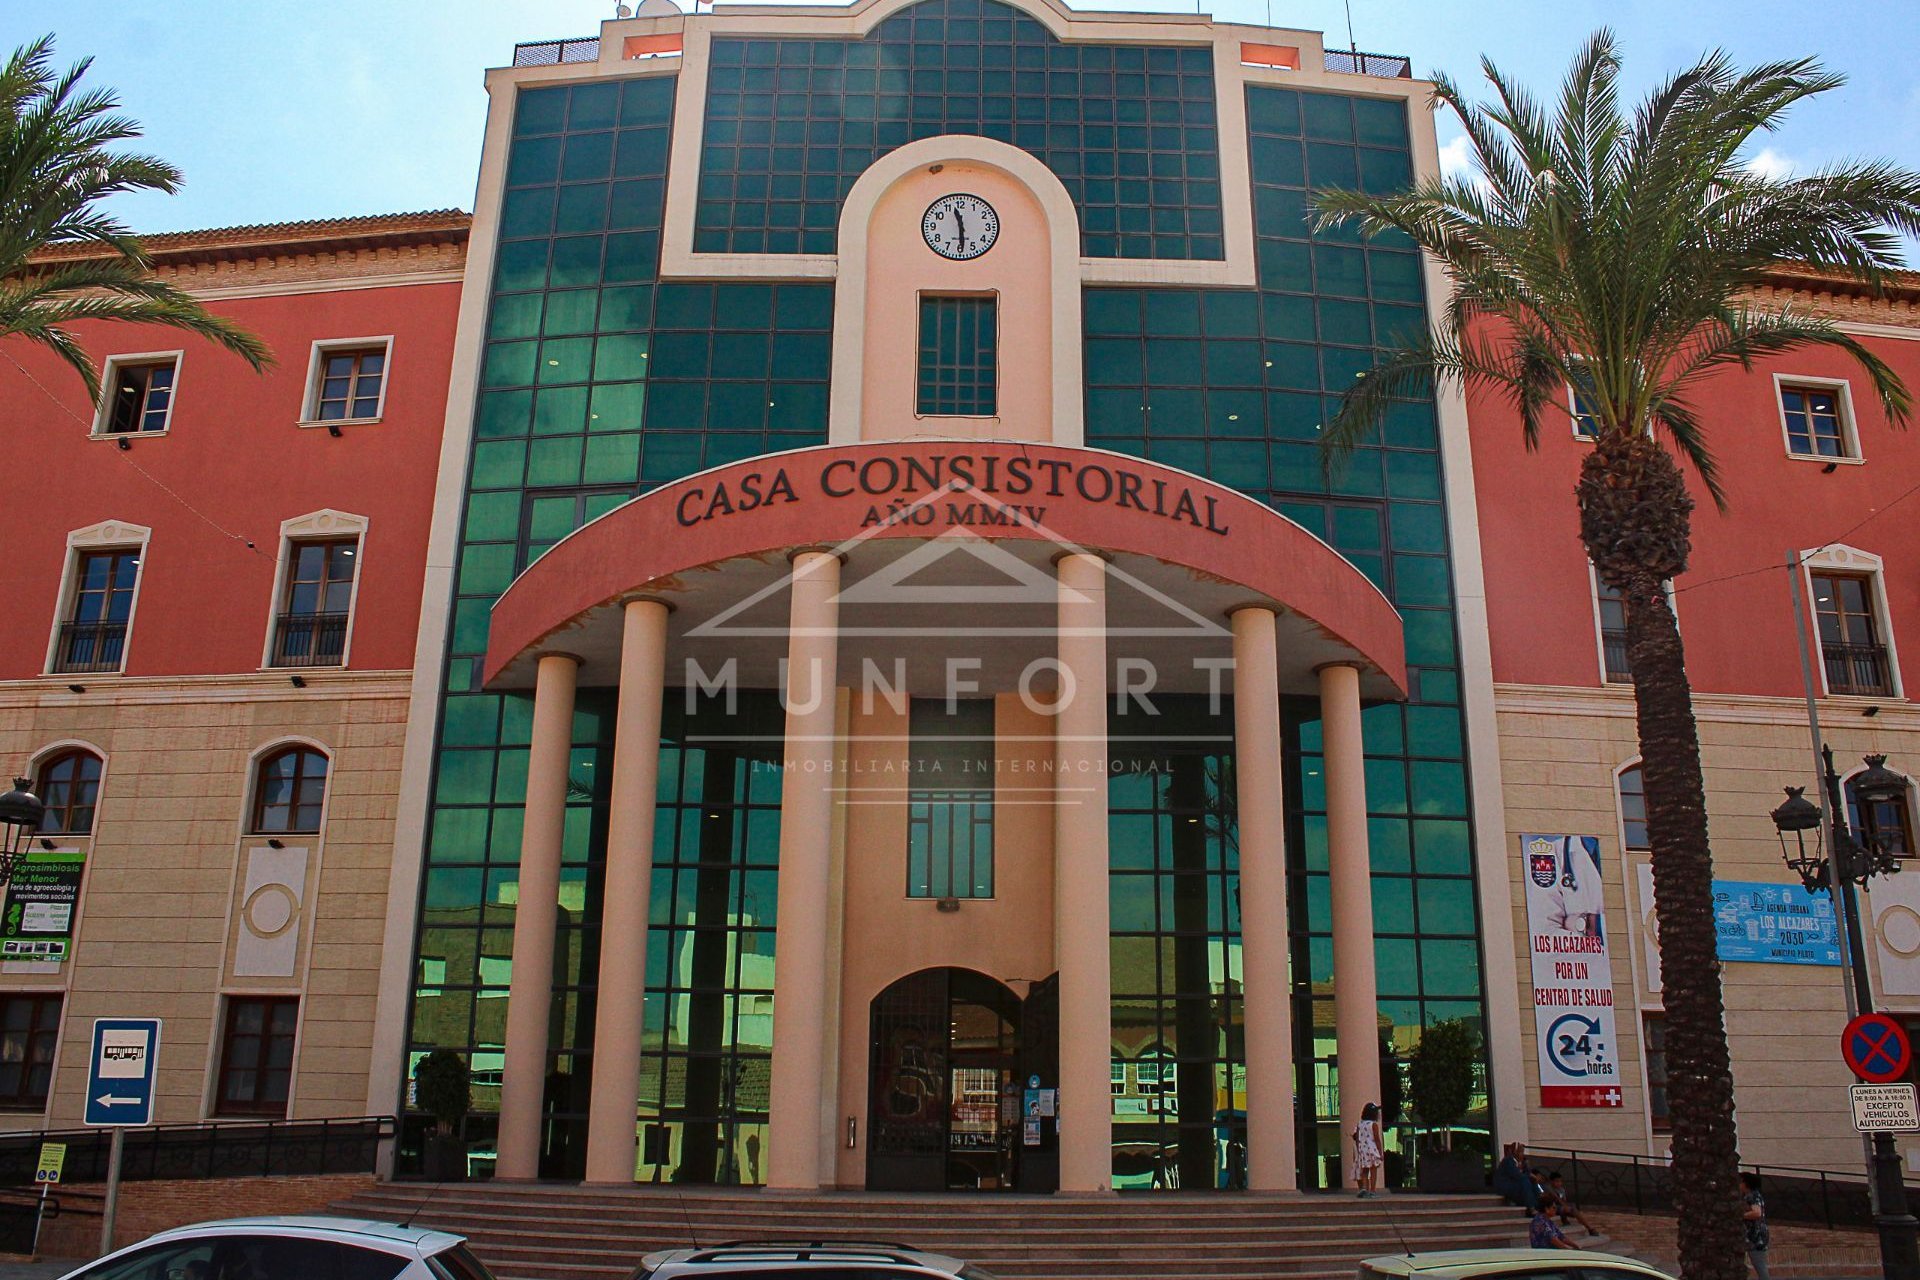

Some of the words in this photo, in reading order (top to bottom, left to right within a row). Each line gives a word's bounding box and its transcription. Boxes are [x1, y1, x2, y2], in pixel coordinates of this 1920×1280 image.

[956, 201, 965, 209] 12
[934, 212, 944, 220] 10
[981, 211, 987, 219] 2
[930, 222, 936, 230] 9
[985, 223, 991, 232] 3
[934, 234, 941, 242] 8
[980, 235, 986, 243] 4
[945, 242, 950, 250] 7
[970, 242, 976, 250] 5
[676, 468, 800, 526] CASA
[820, 455, 1228, 536] CONSISTORIAL
[860, 498, 936, 527] AÑO
[946, 504, 1046, 528] MMIV
[14, 864, 80, 873] Agrosimbiosis
[1766, 904, 1787, 913] AGENDA
[1790, 904, 1810, 914] URBANA
[1760, 915, 1775, 929] LOS
[1780, 931, 1804, 945] 2030
[1534, 935, 1550, 953] LOS
[1553, 932, 1604, 956] ALCÁZARES,
[1771, 948, 1796, 957] MUNICIPIO
[1798, 949, 1814, 959] PILOTO
[1555, 962, 1573, 979] POR
[1575, 962, 1588, 979] UN
[1535, 988, 1570, 1006] CENTRO
[1572, 988, 1583, 1006] DE
[1585, 988, 1613, 1006] SALUD
[1558, 1034, 1592, 1056] 24
[1586, 1060, 1612, 1074] horas
